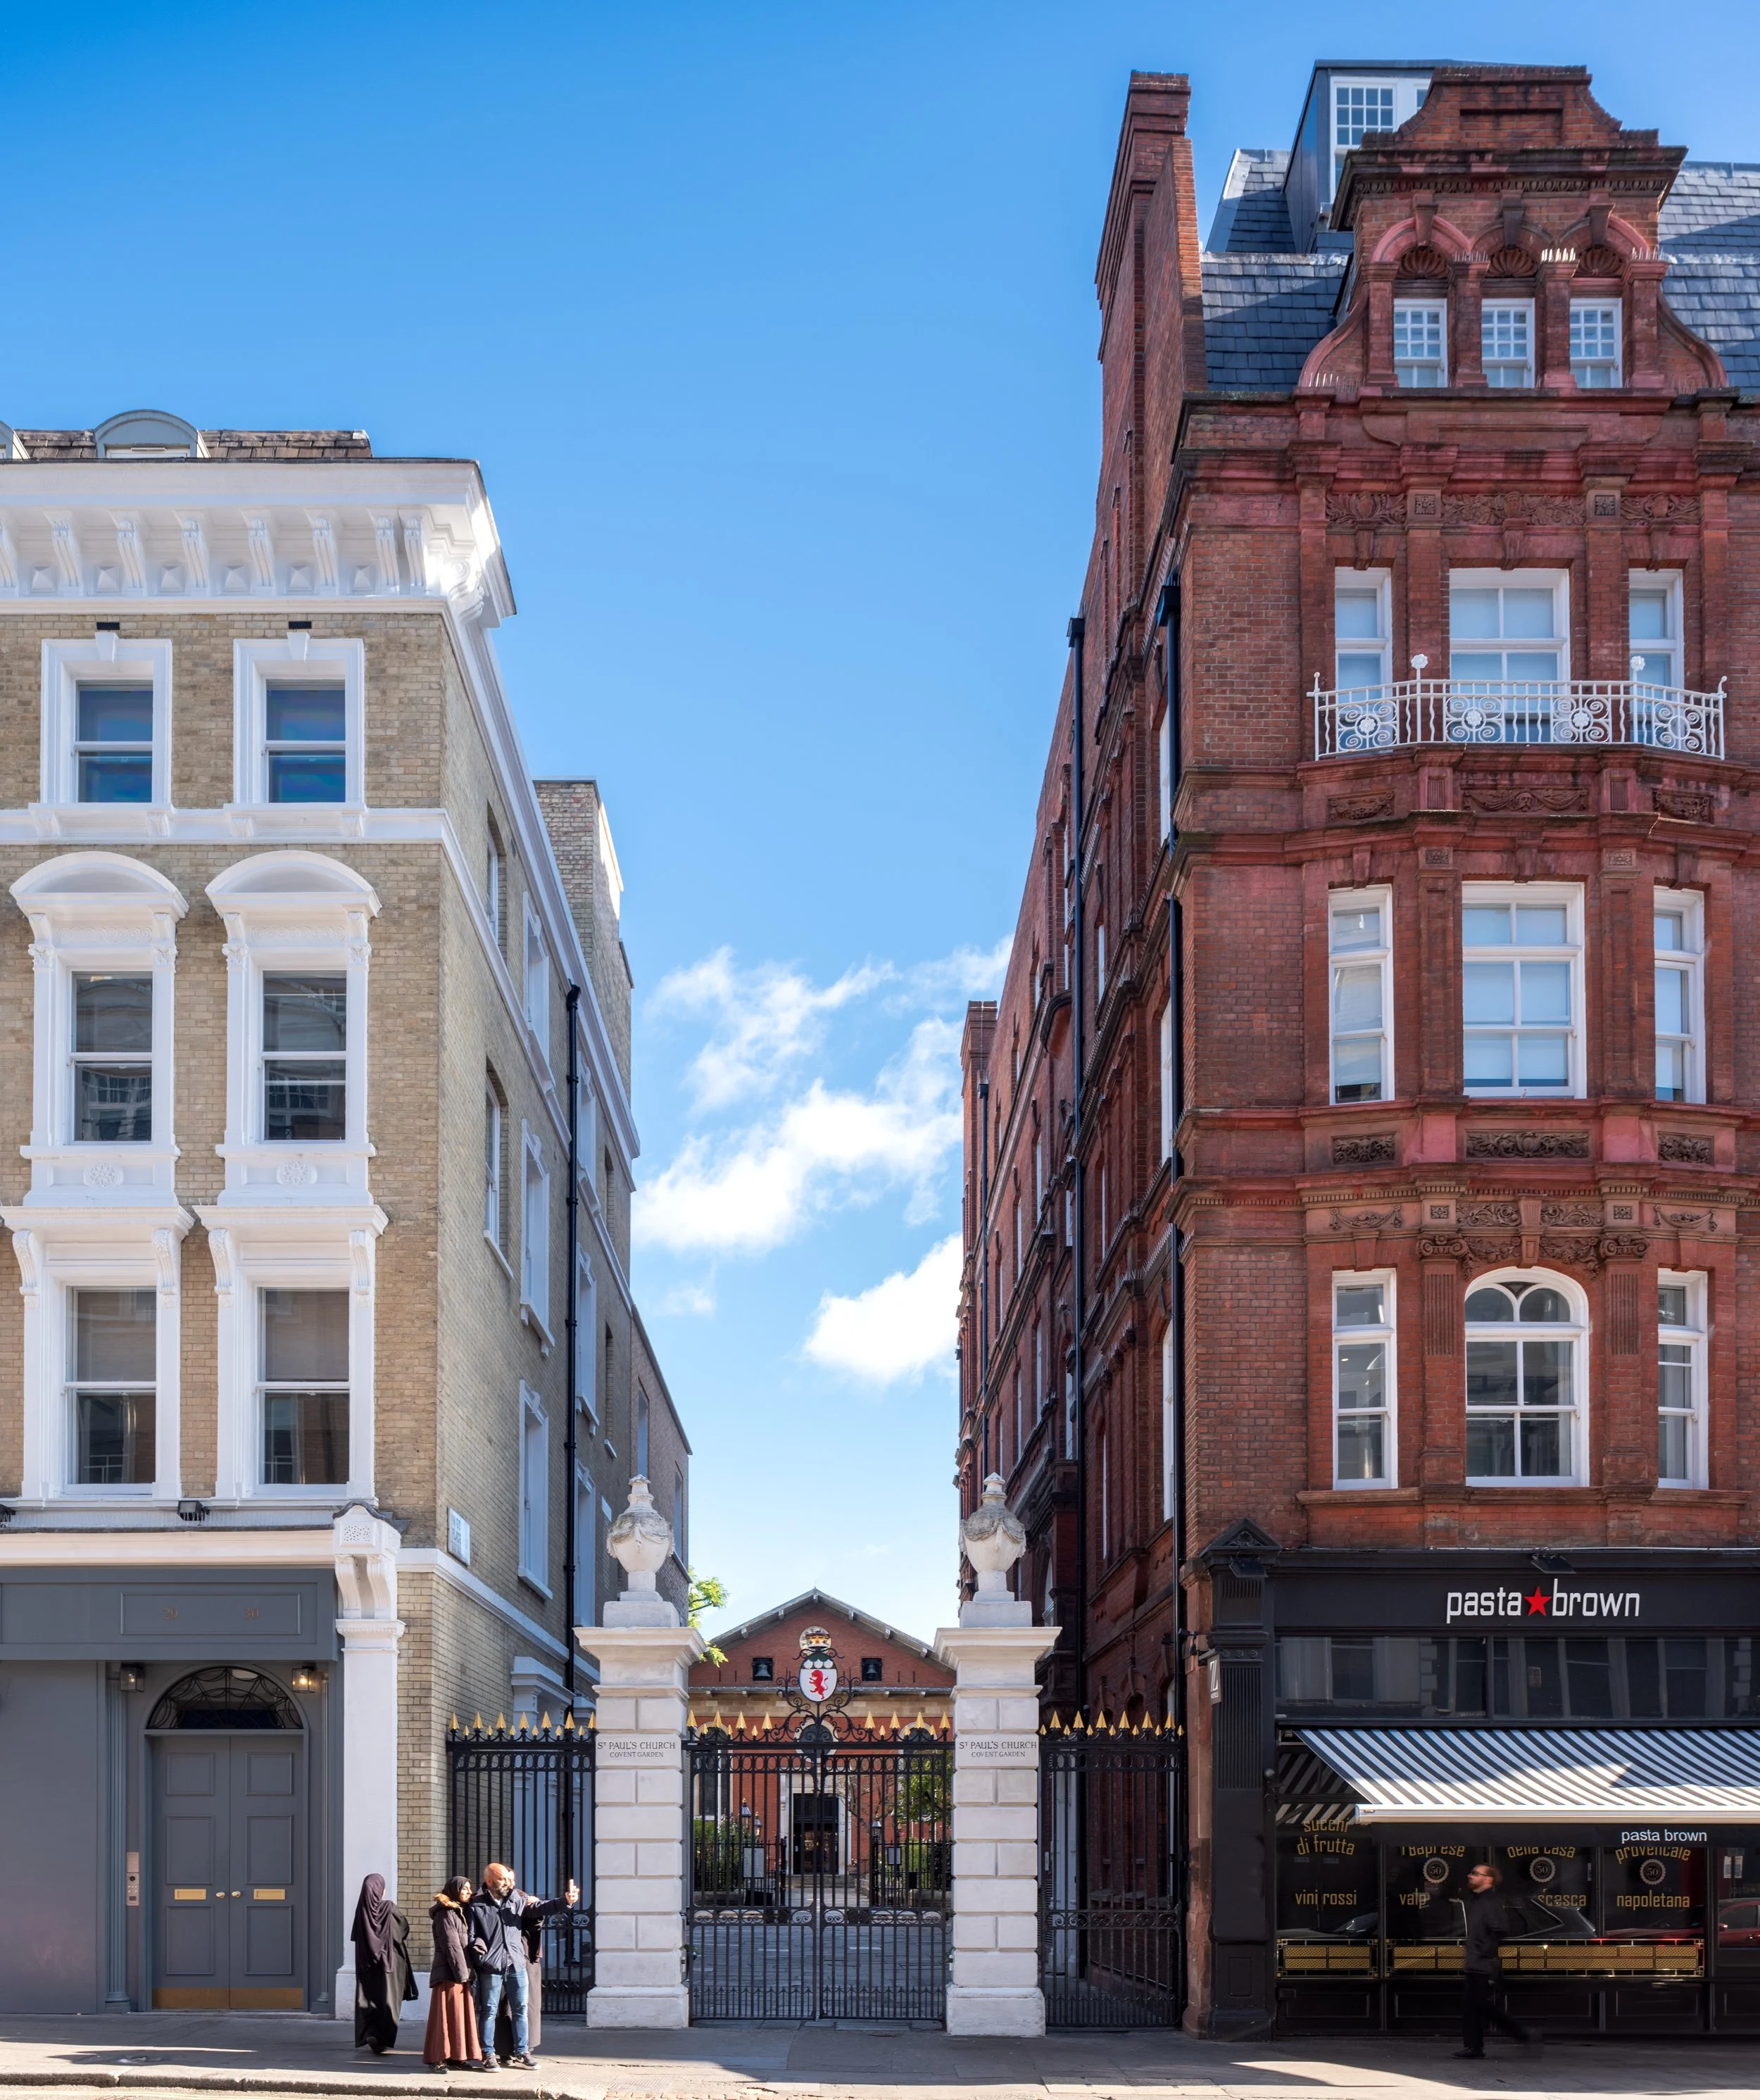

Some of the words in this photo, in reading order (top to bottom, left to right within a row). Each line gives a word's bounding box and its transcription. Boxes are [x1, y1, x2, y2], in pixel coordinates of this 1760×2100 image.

[1447, 1587, 1521, 1623] pasta
[1552, 1578, 1640, 1616] brown
[970, 1741, 998, 1749] PAUL'S
[1622, 1830, 1660, 1844] pasta
[1664, 1829, 1707, 1842] brown
[1297, 1837, 1310, 1855] di
[1314, 1835, 1355, 1855] frutta
[1430, 1866, 1442, 1875] 50
[1536, 1866, 1549, 1874] 50
[1647, 1868, 1659, 1876] 50
[1295, 1890, 1318, 1905] vini
[1323, 1890, 1357, 1905] rossi
[1616, 1890, 1690, 1911] napoletana
